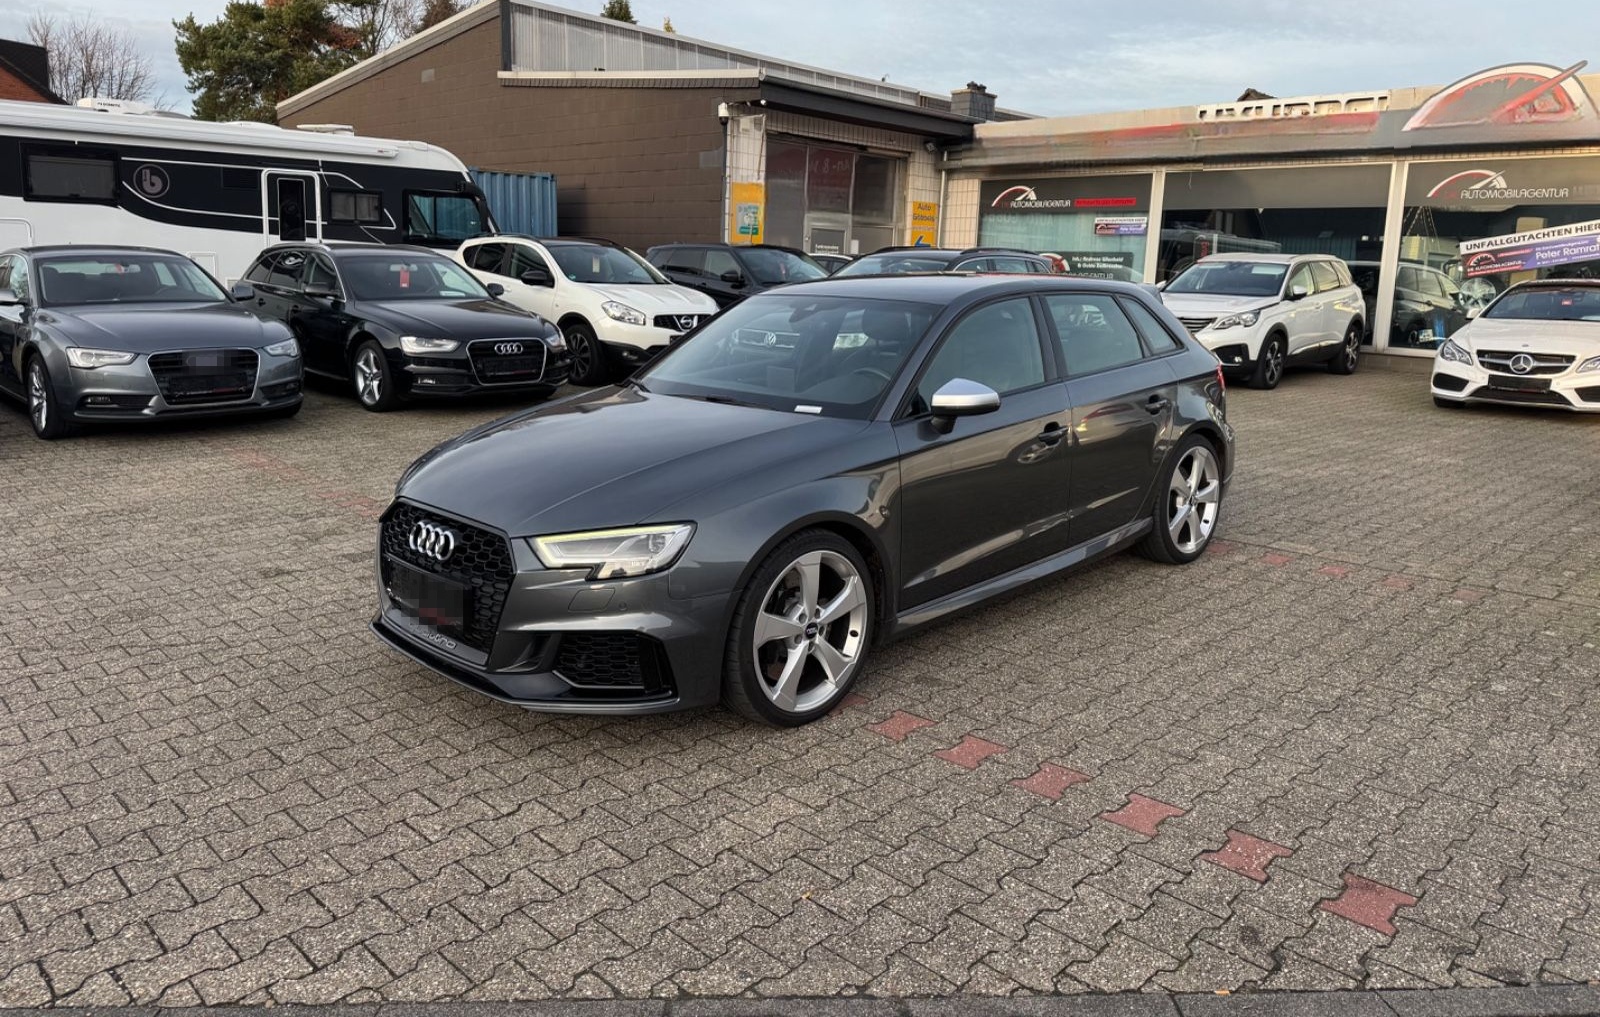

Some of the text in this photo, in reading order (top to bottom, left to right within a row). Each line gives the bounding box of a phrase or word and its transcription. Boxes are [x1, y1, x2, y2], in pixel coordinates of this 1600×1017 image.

[1461, 187, 1569, 200] AUTOMOBILAGENTUR
[1010, 200, 1071, 209] AUTOMOBILAGENTUR
[1465, 227, 1572, 251] UNFALLGUTACHTEN
